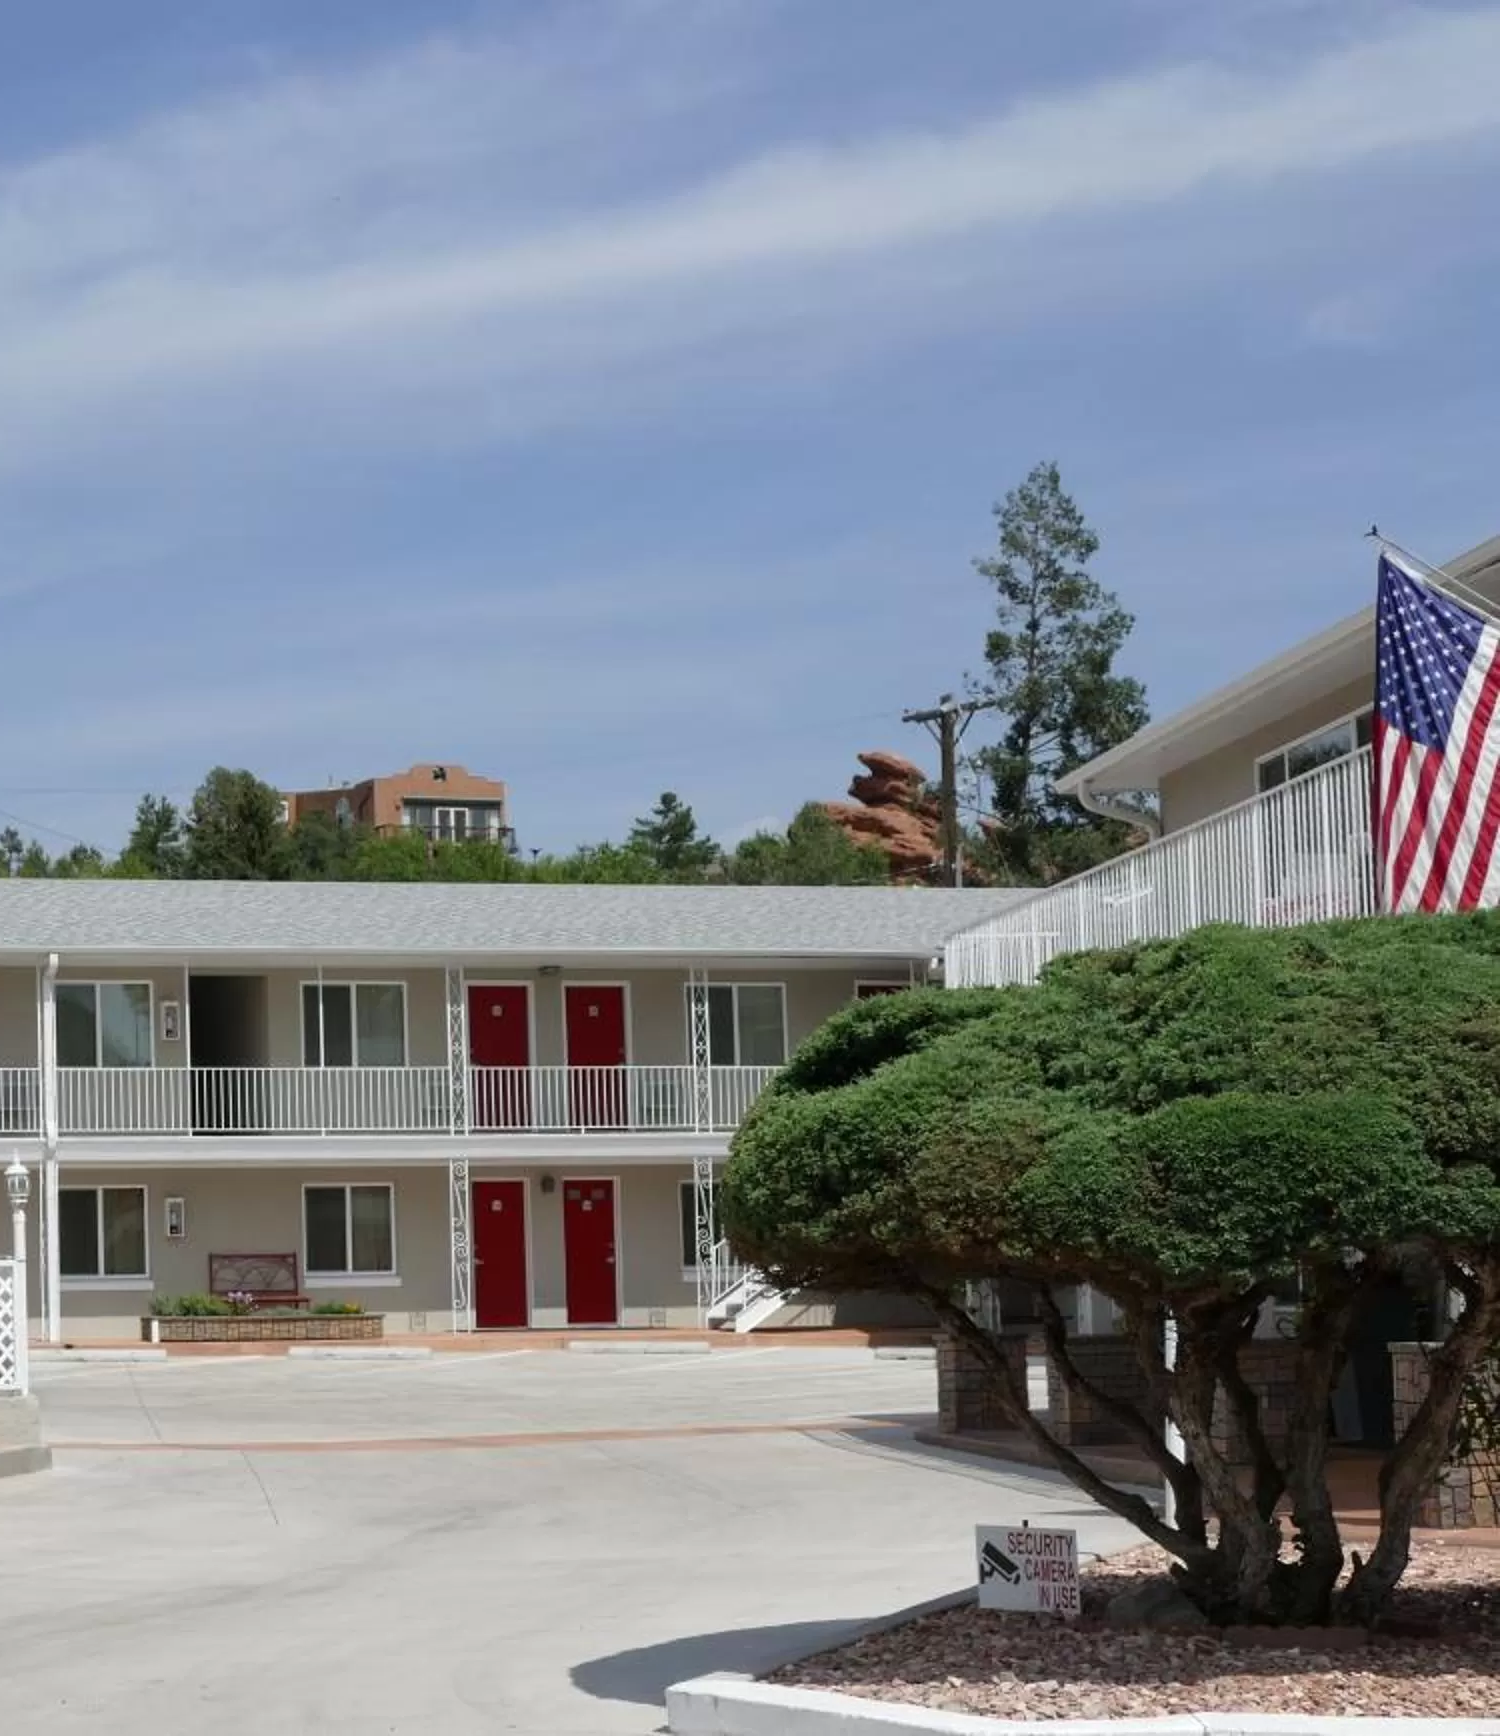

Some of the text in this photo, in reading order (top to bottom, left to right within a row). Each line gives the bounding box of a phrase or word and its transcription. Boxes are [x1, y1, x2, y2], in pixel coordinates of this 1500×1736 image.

[1007, 1532, 1073, 1556] SECURITY
[1024, 1559, 1076, 1583] CAMERA
[1038, 1584, 1077, 1609] IN USE
